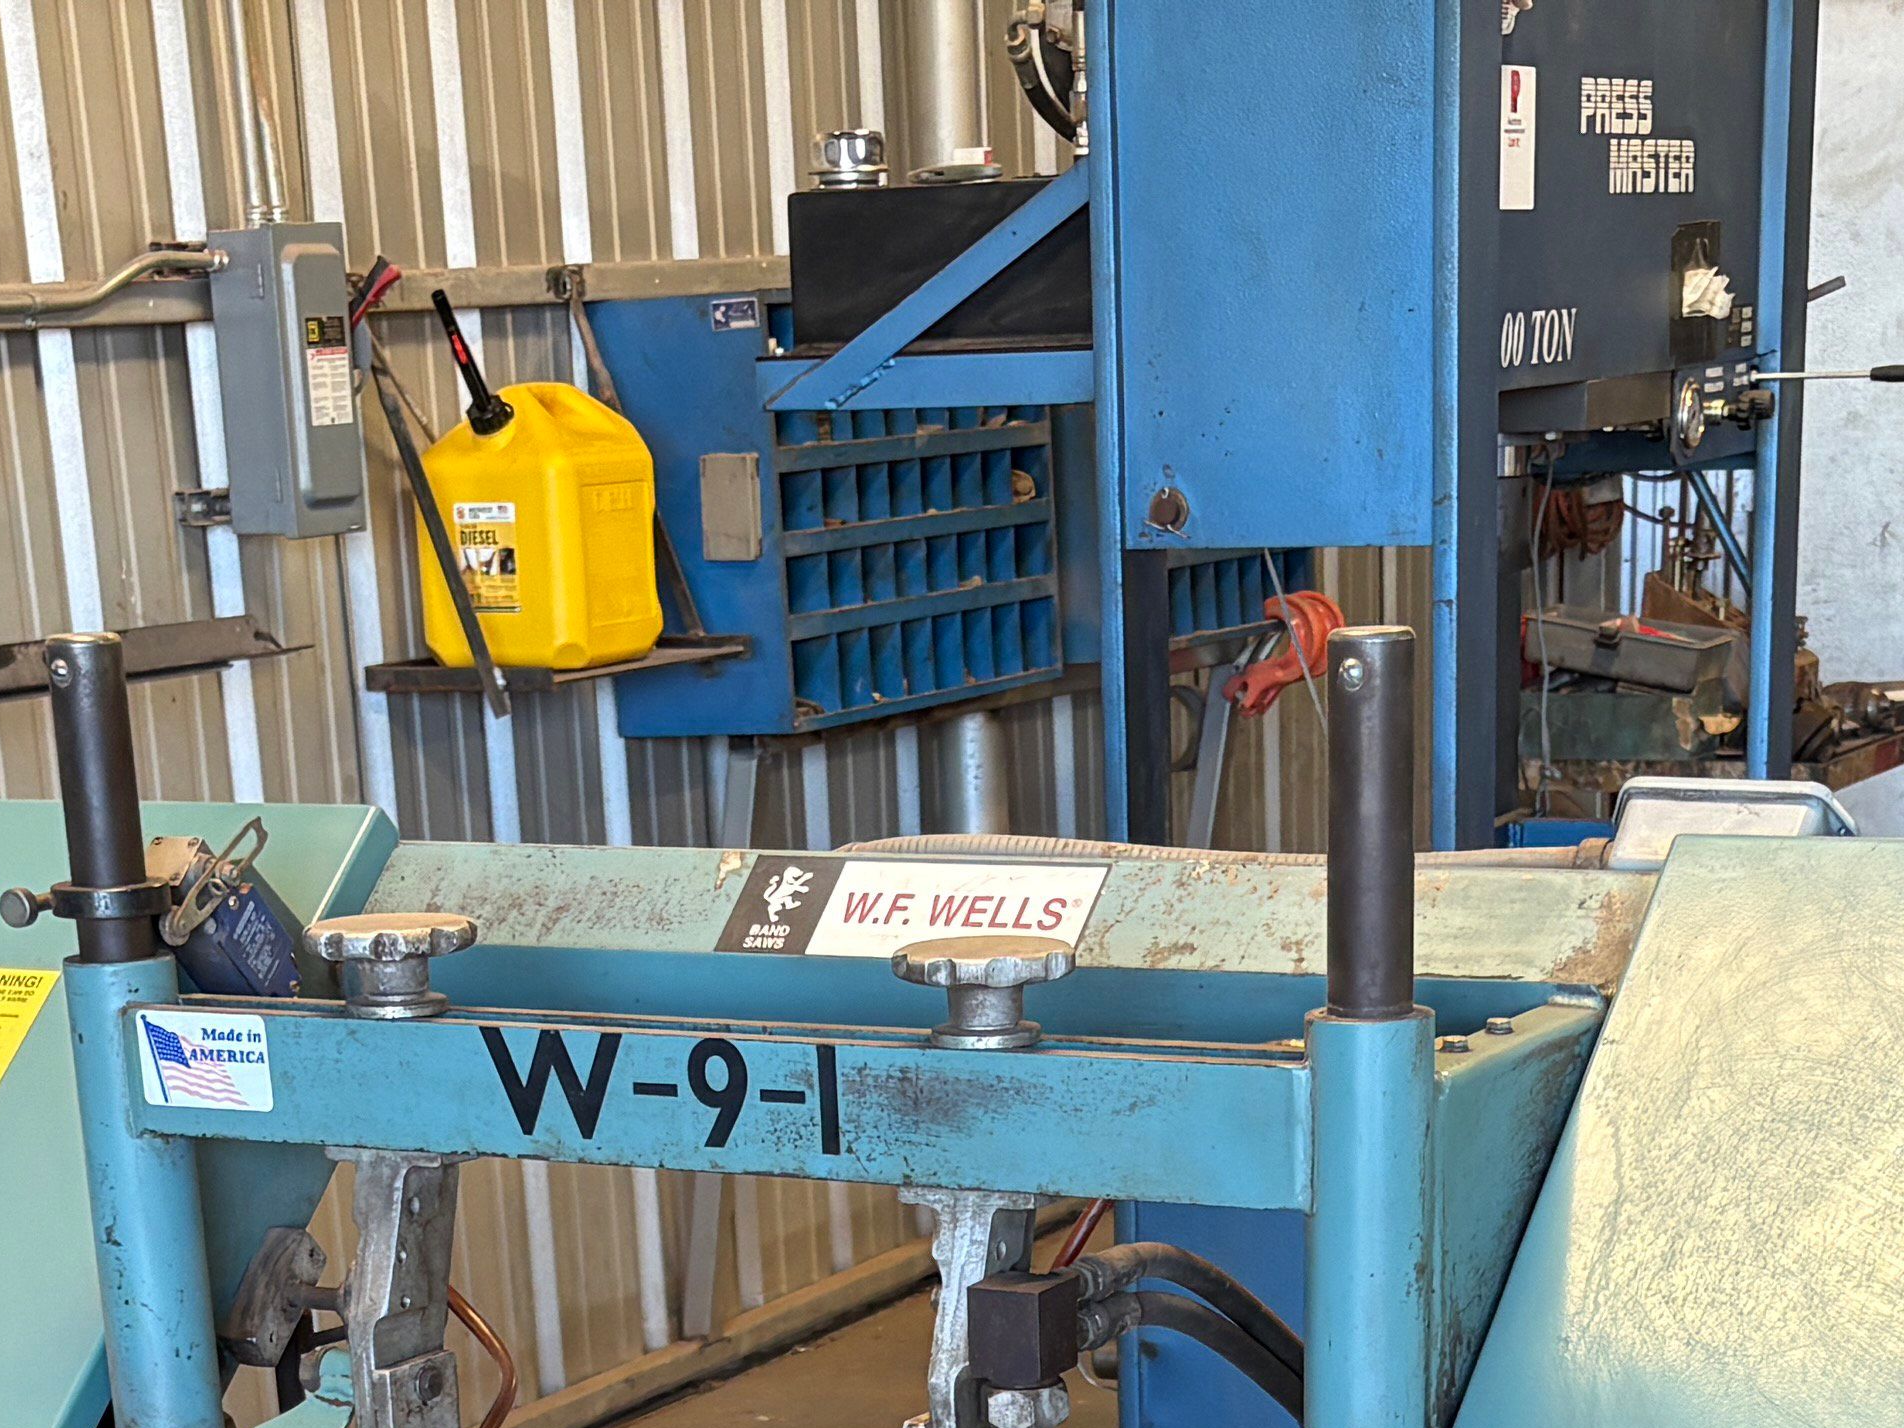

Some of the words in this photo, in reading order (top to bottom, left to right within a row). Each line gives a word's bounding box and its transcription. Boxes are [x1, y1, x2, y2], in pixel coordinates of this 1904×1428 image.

[1580, 77, 1653, 135] PRESS
[1609, 138, 1695, 194] MASTER
[1530, 308, 1577, 365] TON
[461, 530, 499, 546] DIESEL
[843, 892, 915, 926] W.F.
[930, 894, 1067, 931] WELLS
[749, 923, 790, 937] BAND
[742, 936, 786, 950] SAWS
[201, 1027, 243, 1042] Made
[247, 1029, 262, 1043] in
[189, 1048, 265, 1064] AMERICA
